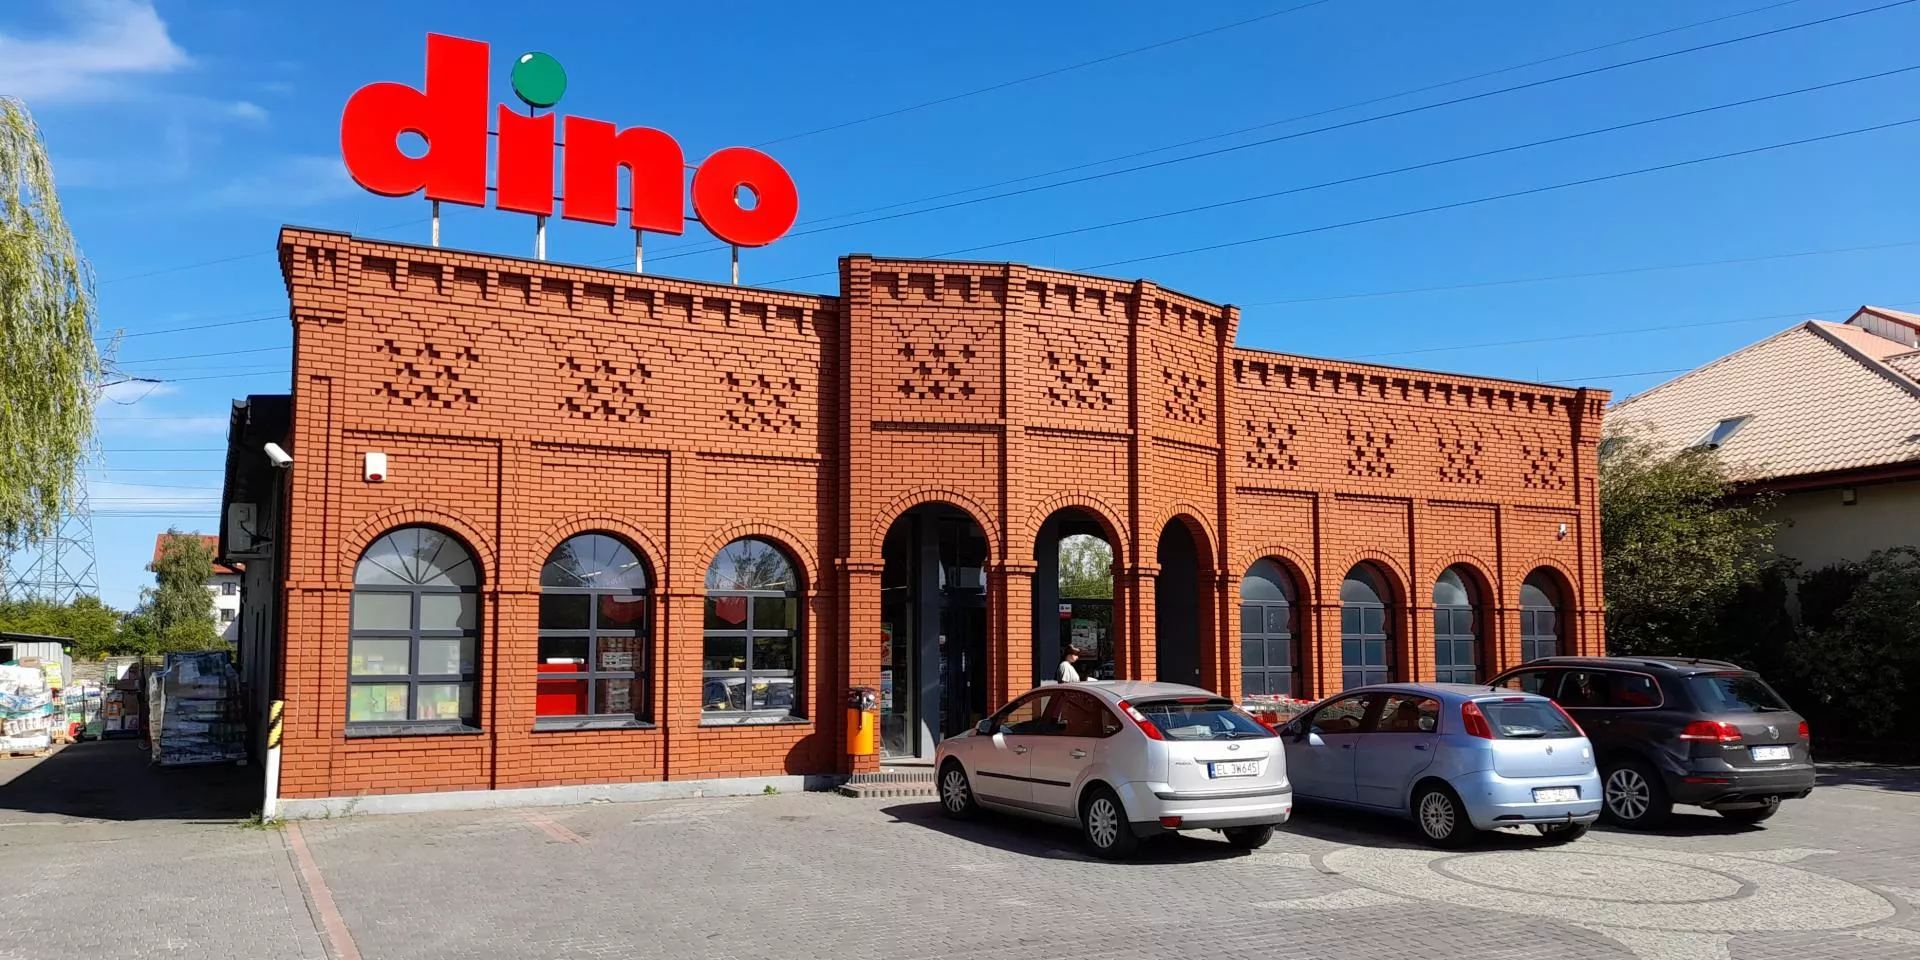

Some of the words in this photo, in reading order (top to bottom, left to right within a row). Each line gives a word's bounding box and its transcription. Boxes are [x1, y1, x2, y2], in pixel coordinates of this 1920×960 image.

[340, 32, 799, 248] dino
[1216, 764, 1228, 775] EL
[1231, 762, 1257, 774] 3W645
